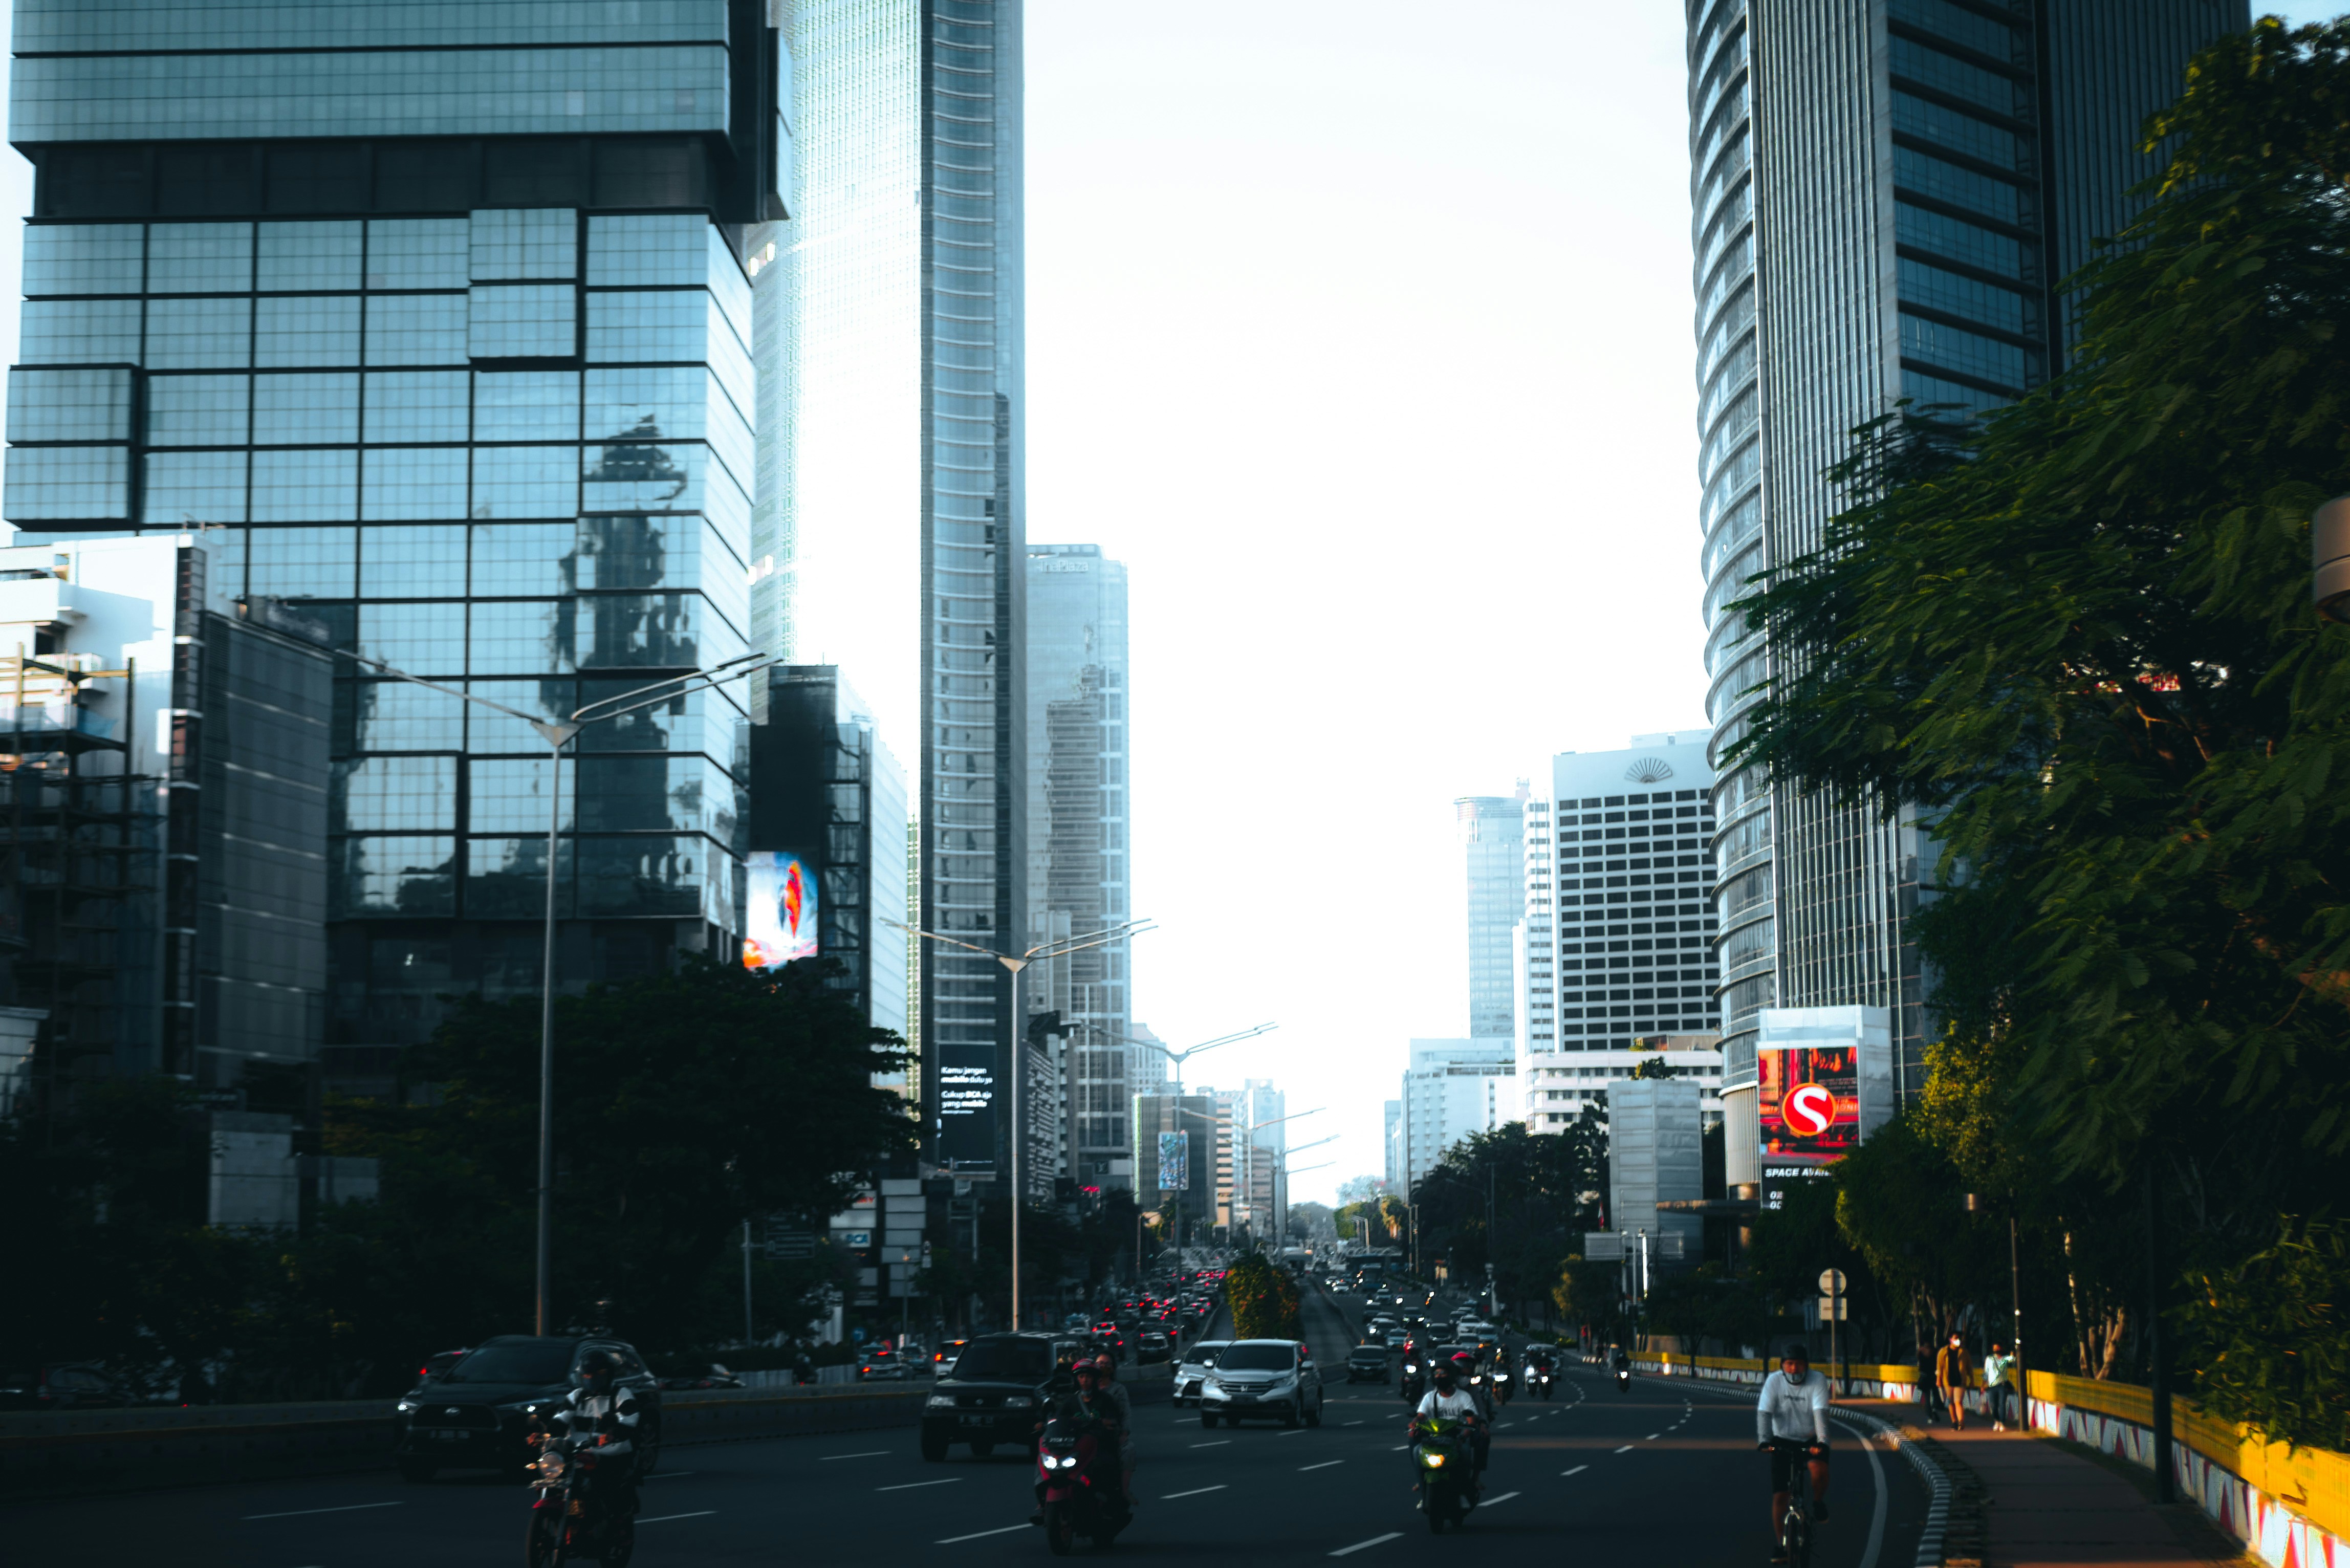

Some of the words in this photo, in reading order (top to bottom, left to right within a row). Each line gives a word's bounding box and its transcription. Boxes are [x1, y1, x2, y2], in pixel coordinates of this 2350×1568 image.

[963, 1067, 987, 1076] jangan
[941, 1091, 965, 1099] Cukup
[1765, 1168, 1800, 1177] SPACE
